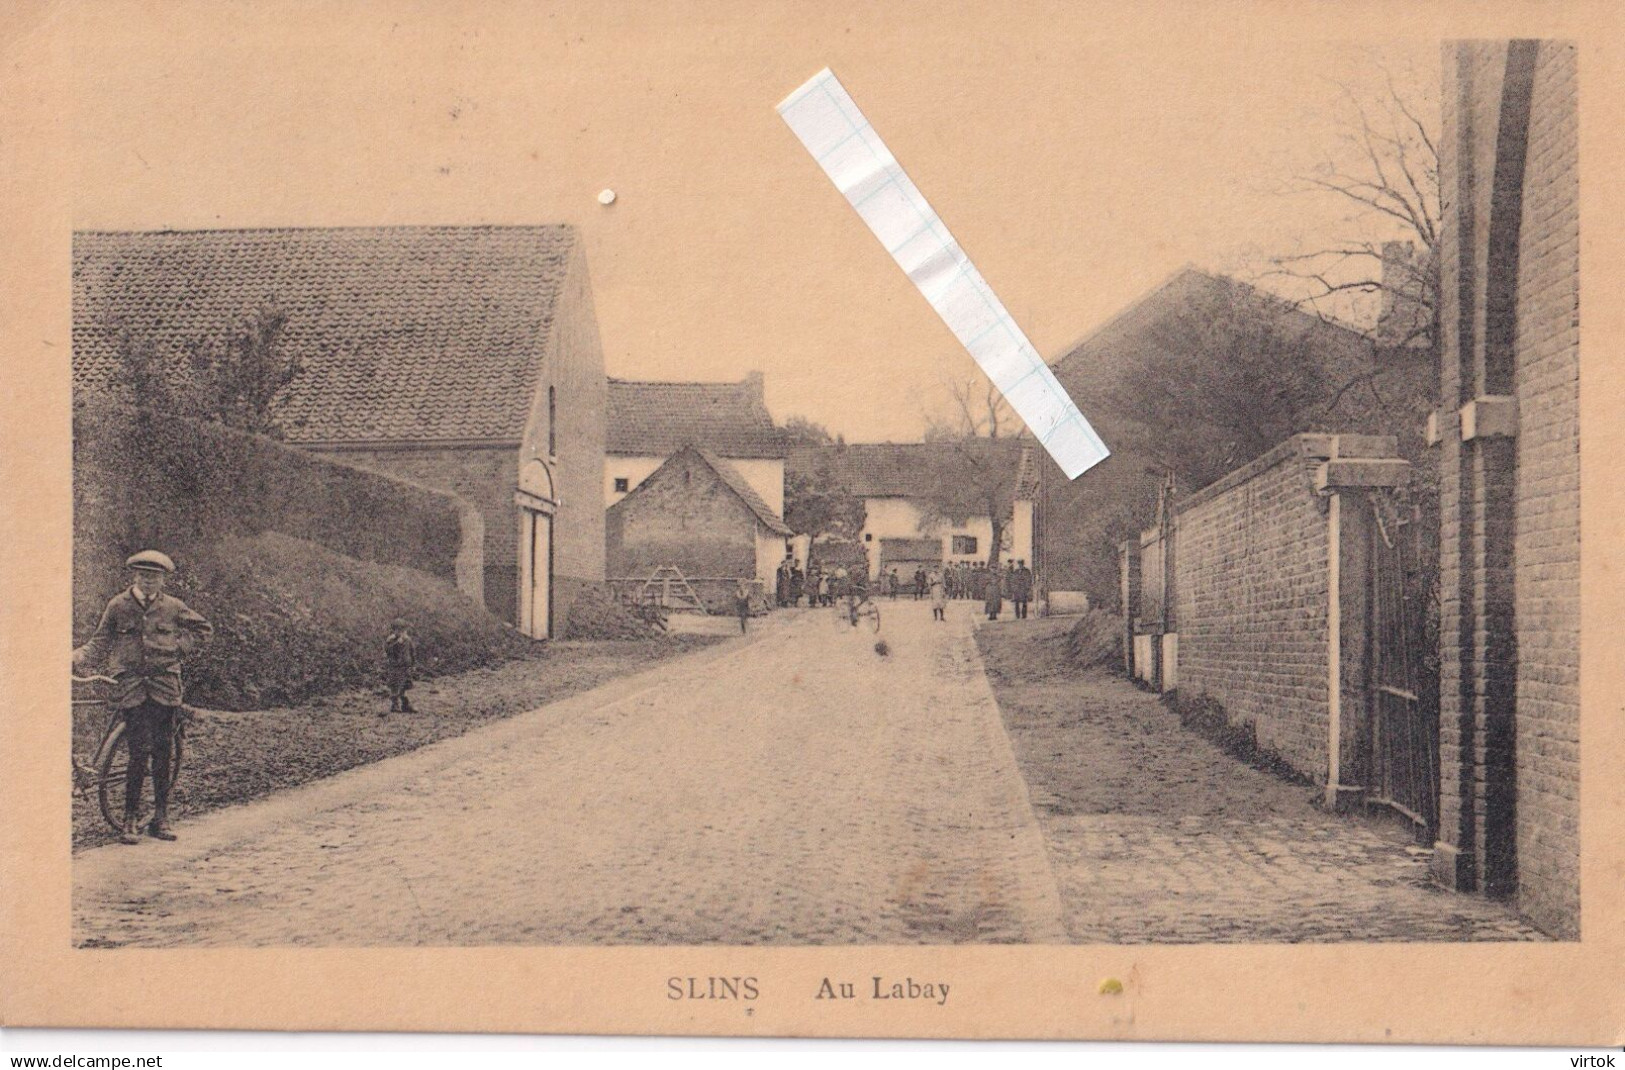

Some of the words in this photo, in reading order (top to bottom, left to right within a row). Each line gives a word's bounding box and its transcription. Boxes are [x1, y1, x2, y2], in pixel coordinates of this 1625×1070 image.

[667, 977, 760, 1000] SLINS
[815, 977, 854, 999] Au
[872, 977, 951, 1005] Labay
